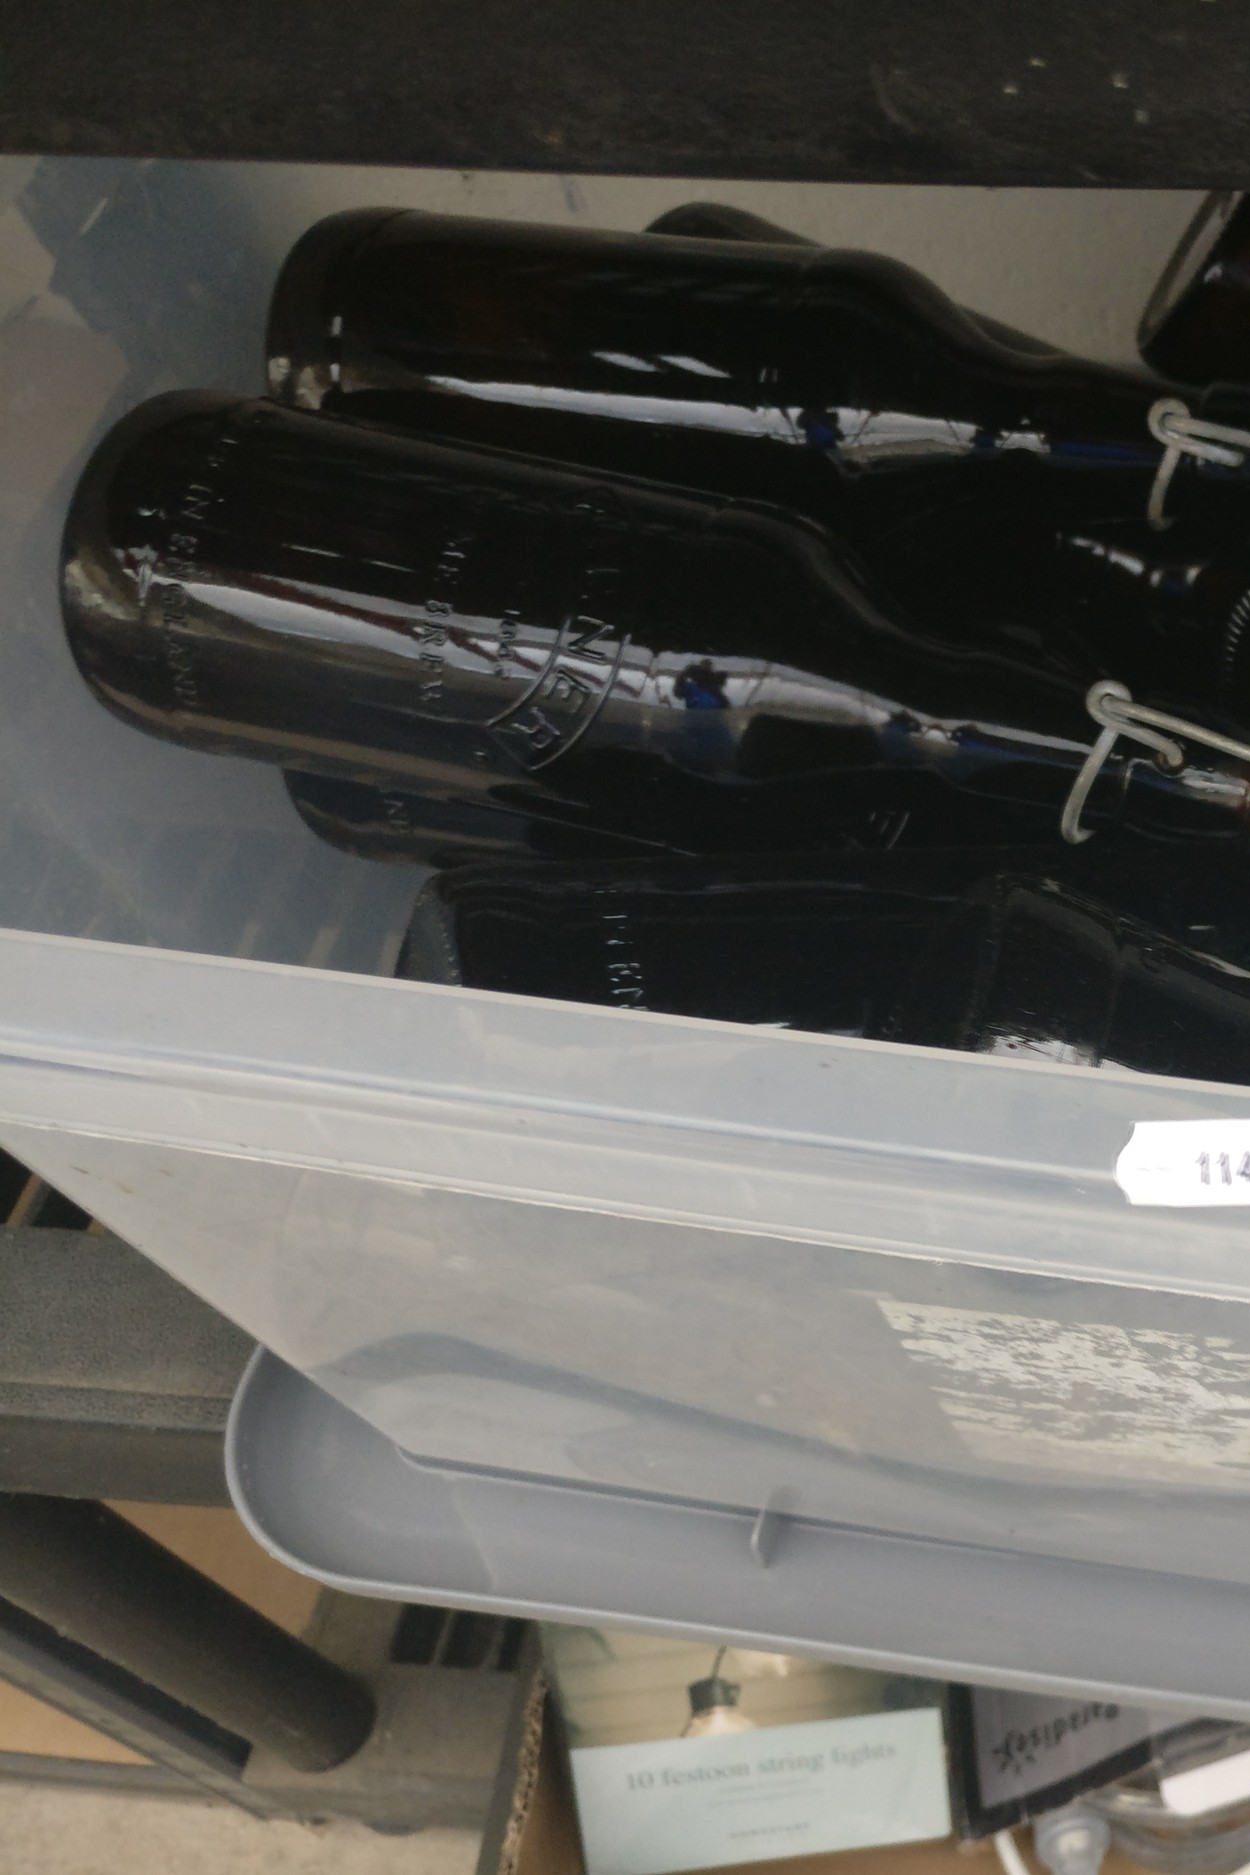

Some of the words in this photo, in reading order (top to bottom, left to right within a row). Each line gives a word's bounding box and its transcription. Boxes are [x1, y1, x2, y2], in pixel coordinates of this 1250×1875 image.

[626, 1770, 655, 1790] 10
[661, 1762, 751, 1787] festoon
[756, 1754, 825, 1773] string
[830, 1743, 897, 1769] lights
